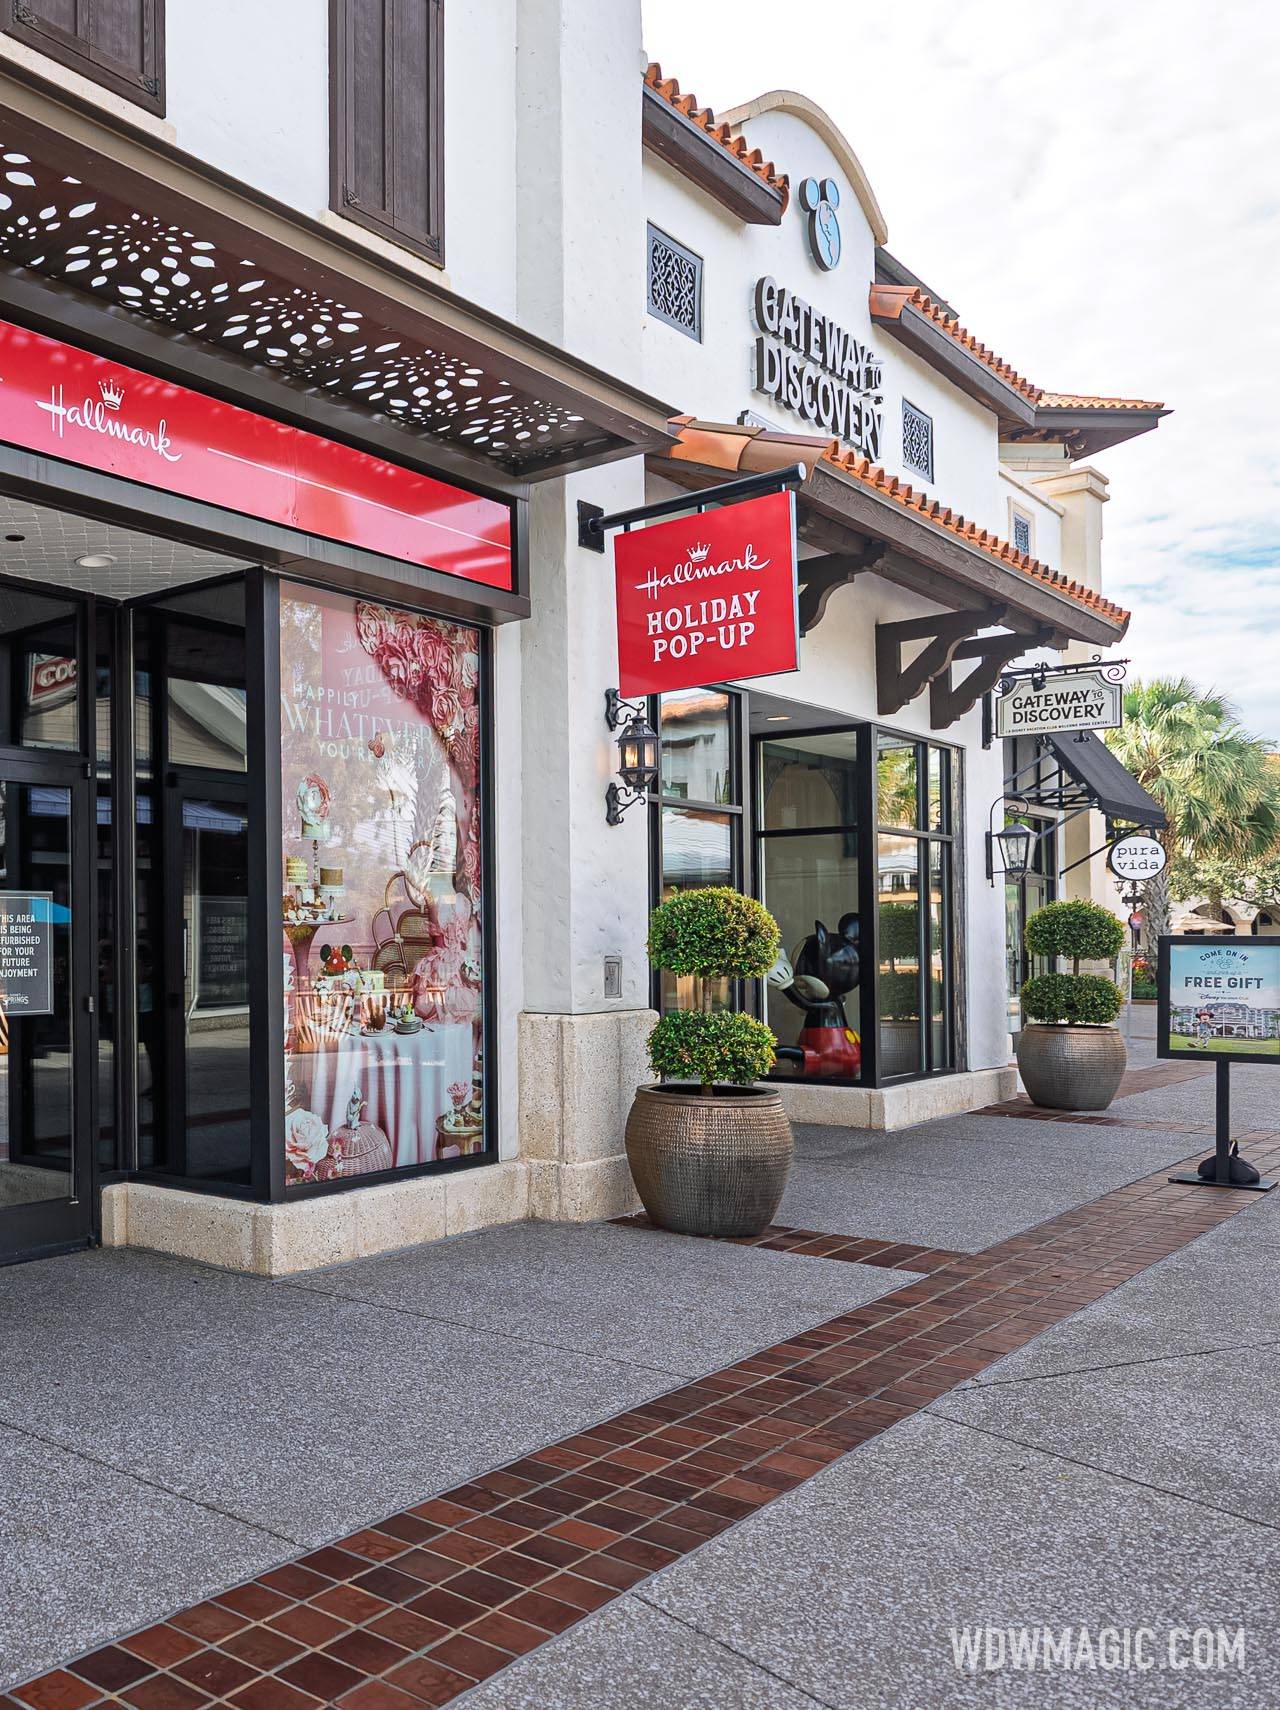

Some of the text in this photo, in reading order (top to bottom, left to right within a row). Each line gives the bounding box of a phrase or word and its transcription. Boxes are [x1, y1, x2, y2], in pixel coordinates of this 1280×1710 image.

[755, 276, 873, 393] GATEWAY
[756, 336, 885, 463] DISCOVERY
[34, 383, 183, 462] Hallmark
[634, 543, 770, 600] Hallmark
[646, 590, 761, 636] HOLIDAY
[652, 621, 755, 662] POP-UP
[293, 681, 359, 709] HAPPILY
[1012, 689, 1103, 710] GATEWAY TO
[1012, 702, 1105, 724] DISCOVERY
[1117, 845, 1160, 859] pura
[1117, 854, 1160, 870] vida
[16, 914, 36, 923] AREA
[0, 925, 32, 934] IS BEING
[15, 946, 35, 956] YOUR
[1200, 950, 1222, 961] COME
[1239, 954, 1248, 962] IN
[2, 957, 30, 967] FUTURE
[1184, 976, 1264, 989] FREE GIFT
